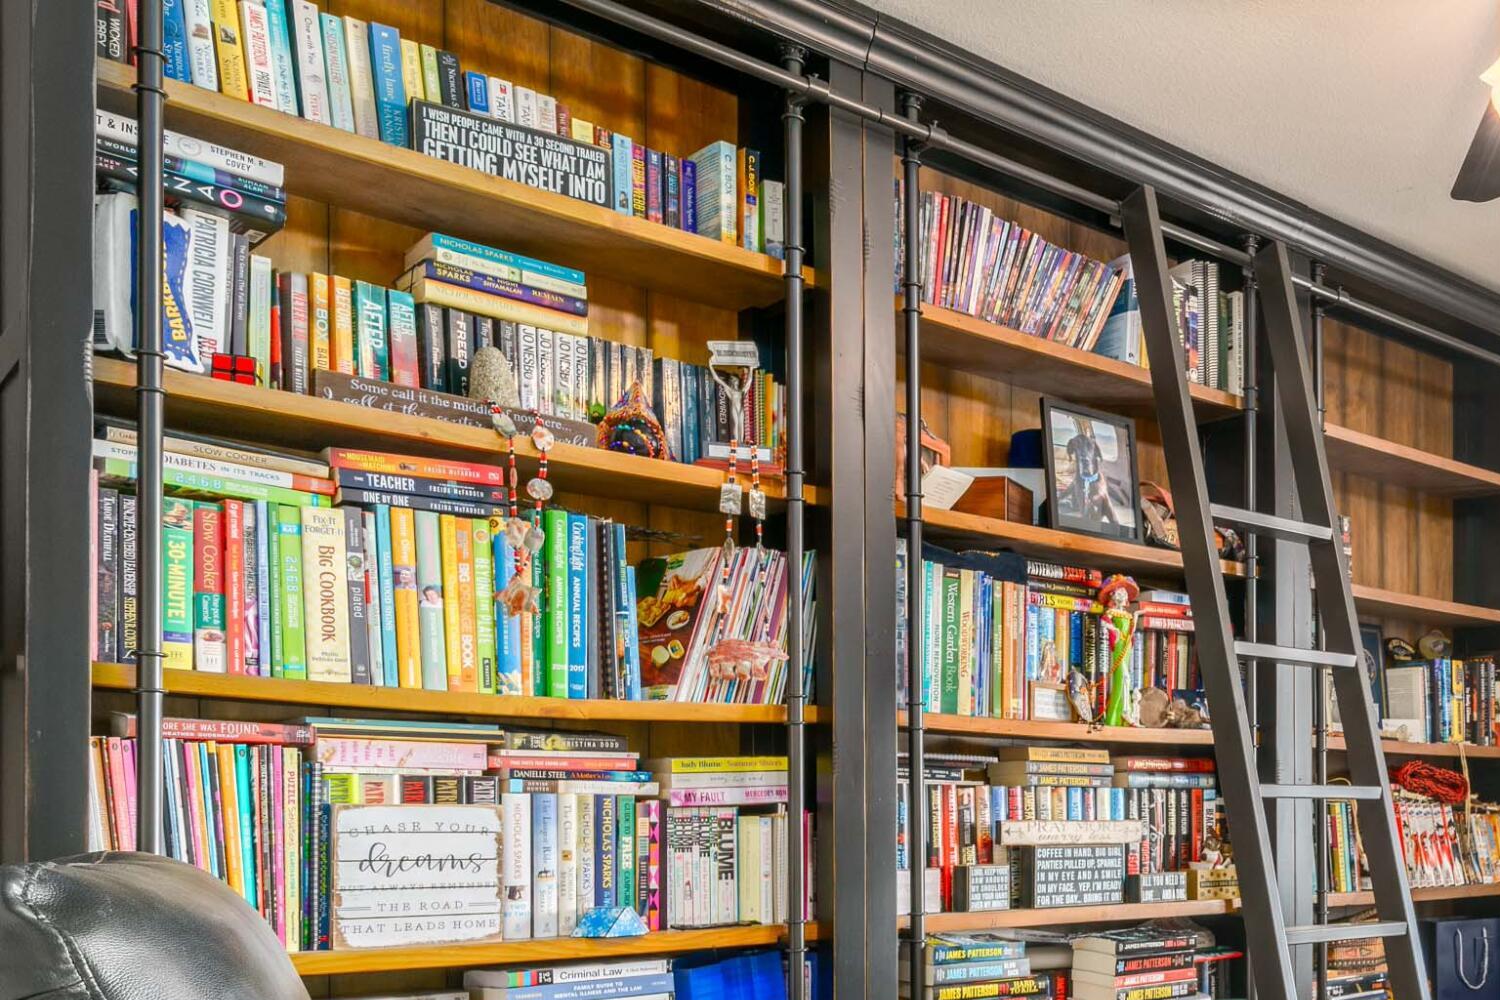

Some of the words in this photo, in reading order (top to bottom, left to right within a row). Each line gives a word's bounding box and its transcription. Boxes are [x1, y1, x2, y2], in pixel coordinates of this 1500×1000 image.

[98, 20, 108, 46] PREY
[109, 18, 120, 57] WICKED
[423, 107, 427, 117] I
[429, 109, 450, 122] WISH
[452, 116, 480, 130] PEOPLE
[482, 122, 504, 138] CAME
[506, 128, 526, 144] WITH
[527, 134, 532, 144] A
[534, 136, 544, 148] 30
[546, 138, 575, 156] SECOND
[576, 147, 605, 162] TRAILER
[210, 145, 247, 162] STEPHEN
[424, 118, 458, 144] THEN
[461, 128, 466, 146] I
[468, 130, 512, 158] COULD
[515, 142, 538, 164] SEE
[541, 149, 578, 174] WHAT
[580, 158, 584, 175] I
[586, 161, 606, 181] AM
[226, 158, 251, 172] COVEY
[424, 138, 498, 178] GETTING
[502, 158, 564, 194] MYSELF
[568, 173, 606, 204] INTO
[192, 214, 216, 266] PATRICIA
[436, 268, 471, 284] SPARKS
[532, 290, 566, 303] REMAIN
[192, 267, 216, 330] CORNWELL
[364, 300, 384, 348] AFTER
[400, 304, 414, 336] AFTER
[456, 320, 468, 369] FREED
[351, 379, 388, 396] Some
[392, 388, 416, 403] call
[418, 391, 428, 404] it
[431, 394, 450, 408] the
[193, 445, 223, 456] SLOW
[225, 450, 268, 464] COOKER
[366, 473, 416, 492] TEACHER
[429, 484, 451, 495] FREIDA
[103, 496, 114, 520] TAHOE
[363, 491, 380, 504] ONE
[382, 494, 392, 504] BY
[392, 494, 410, 507] ONE
[430, 502, 452, 512] FREIDA
[202, 512, 217, 542] Slow
[318, 545, 336, 567] BIG
[202, 544, 218, 592] Cooker
[459, 563, 470, 583] BIG
[1028, 561, 1064, 579] PATTERSON
[1064, 566, 1086, 582] ESCAPE
[167, 541, 186, 619] 30-MINUTE
[352, 586, 364, 619] plated
[572, 576, 581, 614] ANNUAL
[946, 582, 958, 622] Western
[1031, 592, 1056, 606] GIRLS
[319, 572, 336, 642] COOKBOOK
[572, 616, 581, 648] RECIPES
[462, 634, 474, 668] BOOK
[946, 624, 958, 664] Garden
[570, 664, 585, 672] 2017
[945, 664, 954, 694] Book
[200, 724, 217, 732] WAS
[220, 723, 260, 734] FOUND
[514, 770, 546, 778] DANIELLE
[548, 771, 568, 779] STEEL
[698, 760, 722, 768] Blume
[1039, 764, 1056, 773] JAMES
[1057, 764, 1088, 774] PATTERSON
[1040, 776, 1058, 785] JAMES
[1059, 776, 1090, 786] PATTERSON
[684, 792, 698, 802] MY
[700, 792, 725, 802] FAULT
[350, 822, 421, 838] CHASE
[435, 822, 489, 837] YOUR
[602, 798, 612, 852] NICHOLAS
[1028, 821, 1067, 833] PRAY
[700, 815, 710, 858] BLUME
[358, 842, 488, 878] dreams
[718, 818, 734, 880] BLUME
[1037, 848, 1064, 858] COFFEE
[1064, 848, 1072, 857] IN
[602, 853, 612, 889] SPARKS
[1037, 859, 1064, 870] PANTIES
[1064, 859, 1086, 870] PULLED
[1096, 858, 1122, 868] SPARKLE
[1048, 872, 1059, 881] MY
[1062, 871, 1075, 880] EYE
[1078, 870, 1092, 880] AND
[1094, 870, 1100, 880] A
[1101, 869, 1122, 879] SMILE
[1038, 883, 1046, 893] ON
[1048, 884, 1059, 893] MY
[1102, 880, 1122, 890] READY
[1165, 876, 1178, 885] NEED
[378, 902, 412, 913] THE
[420, 900, 464, 912] ROAD
[1037, 895, 1050, 905] FOR
[1052, 894, 1064, 904] THE
[342, 923, 386, 934] THAT
[394, 920, 446, 933] LEADS
[452, 918, 498, 930] HOME
[946, 950, 966, 960] JAMES
[967, 948, 1003, 958] PATTERSON
[1124, 960, 1142, 972] JAMES
[1143, 956, 1172, 968] PATTERSON
[560, 968, 600, 980] Criminal
[602, 968, 623, 976] Law
[946, 968, 967, 980] JAMES
[968, 965, 1003, 978] PATTERSON
[962, 984, 998, 999] PATTERSON
[1144, 986, 1172, 1000] PATTERSON
